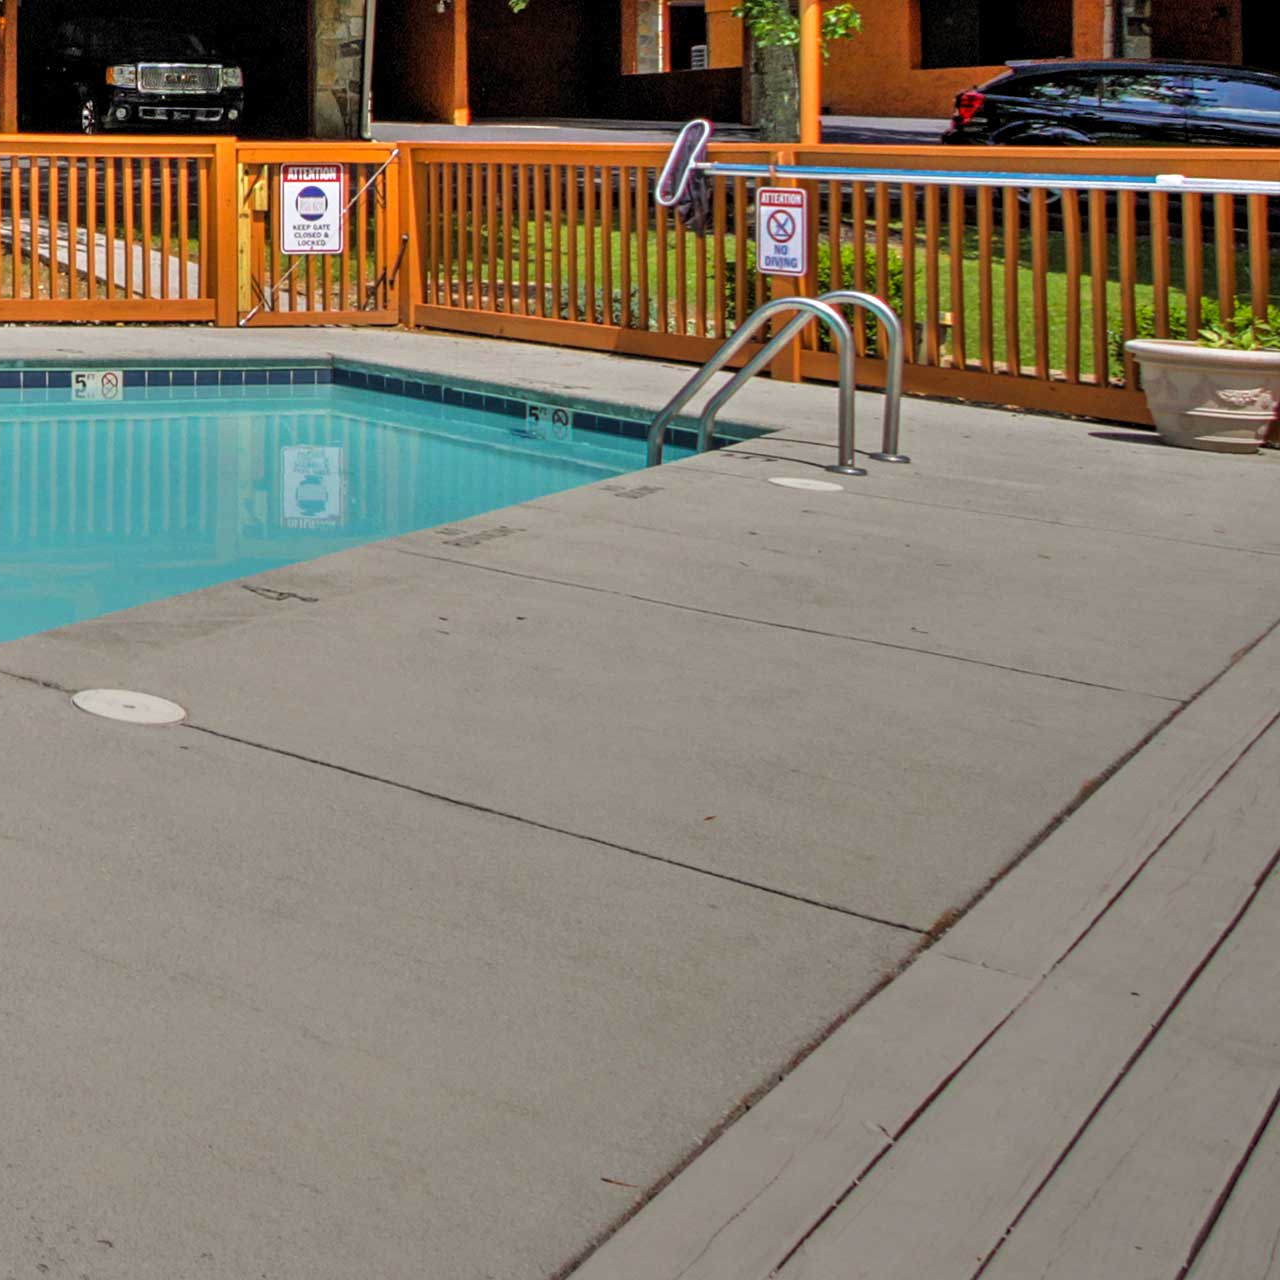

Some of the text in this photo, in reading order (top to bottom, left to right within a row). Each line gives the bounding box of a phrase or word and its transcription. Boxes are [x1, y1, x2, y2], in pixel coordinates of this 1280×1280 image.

[287, 167, 337, 180] ATTENTION
[761, 192, 802, 205] ATTENTION
[297, 239, 326, 247] LOCKED
[774, 244, 788, 255] NO
[764, 256, 798, 268] DIVING
[75, 374, 86, 390] 5
[529, 406, 540, 422] 5
